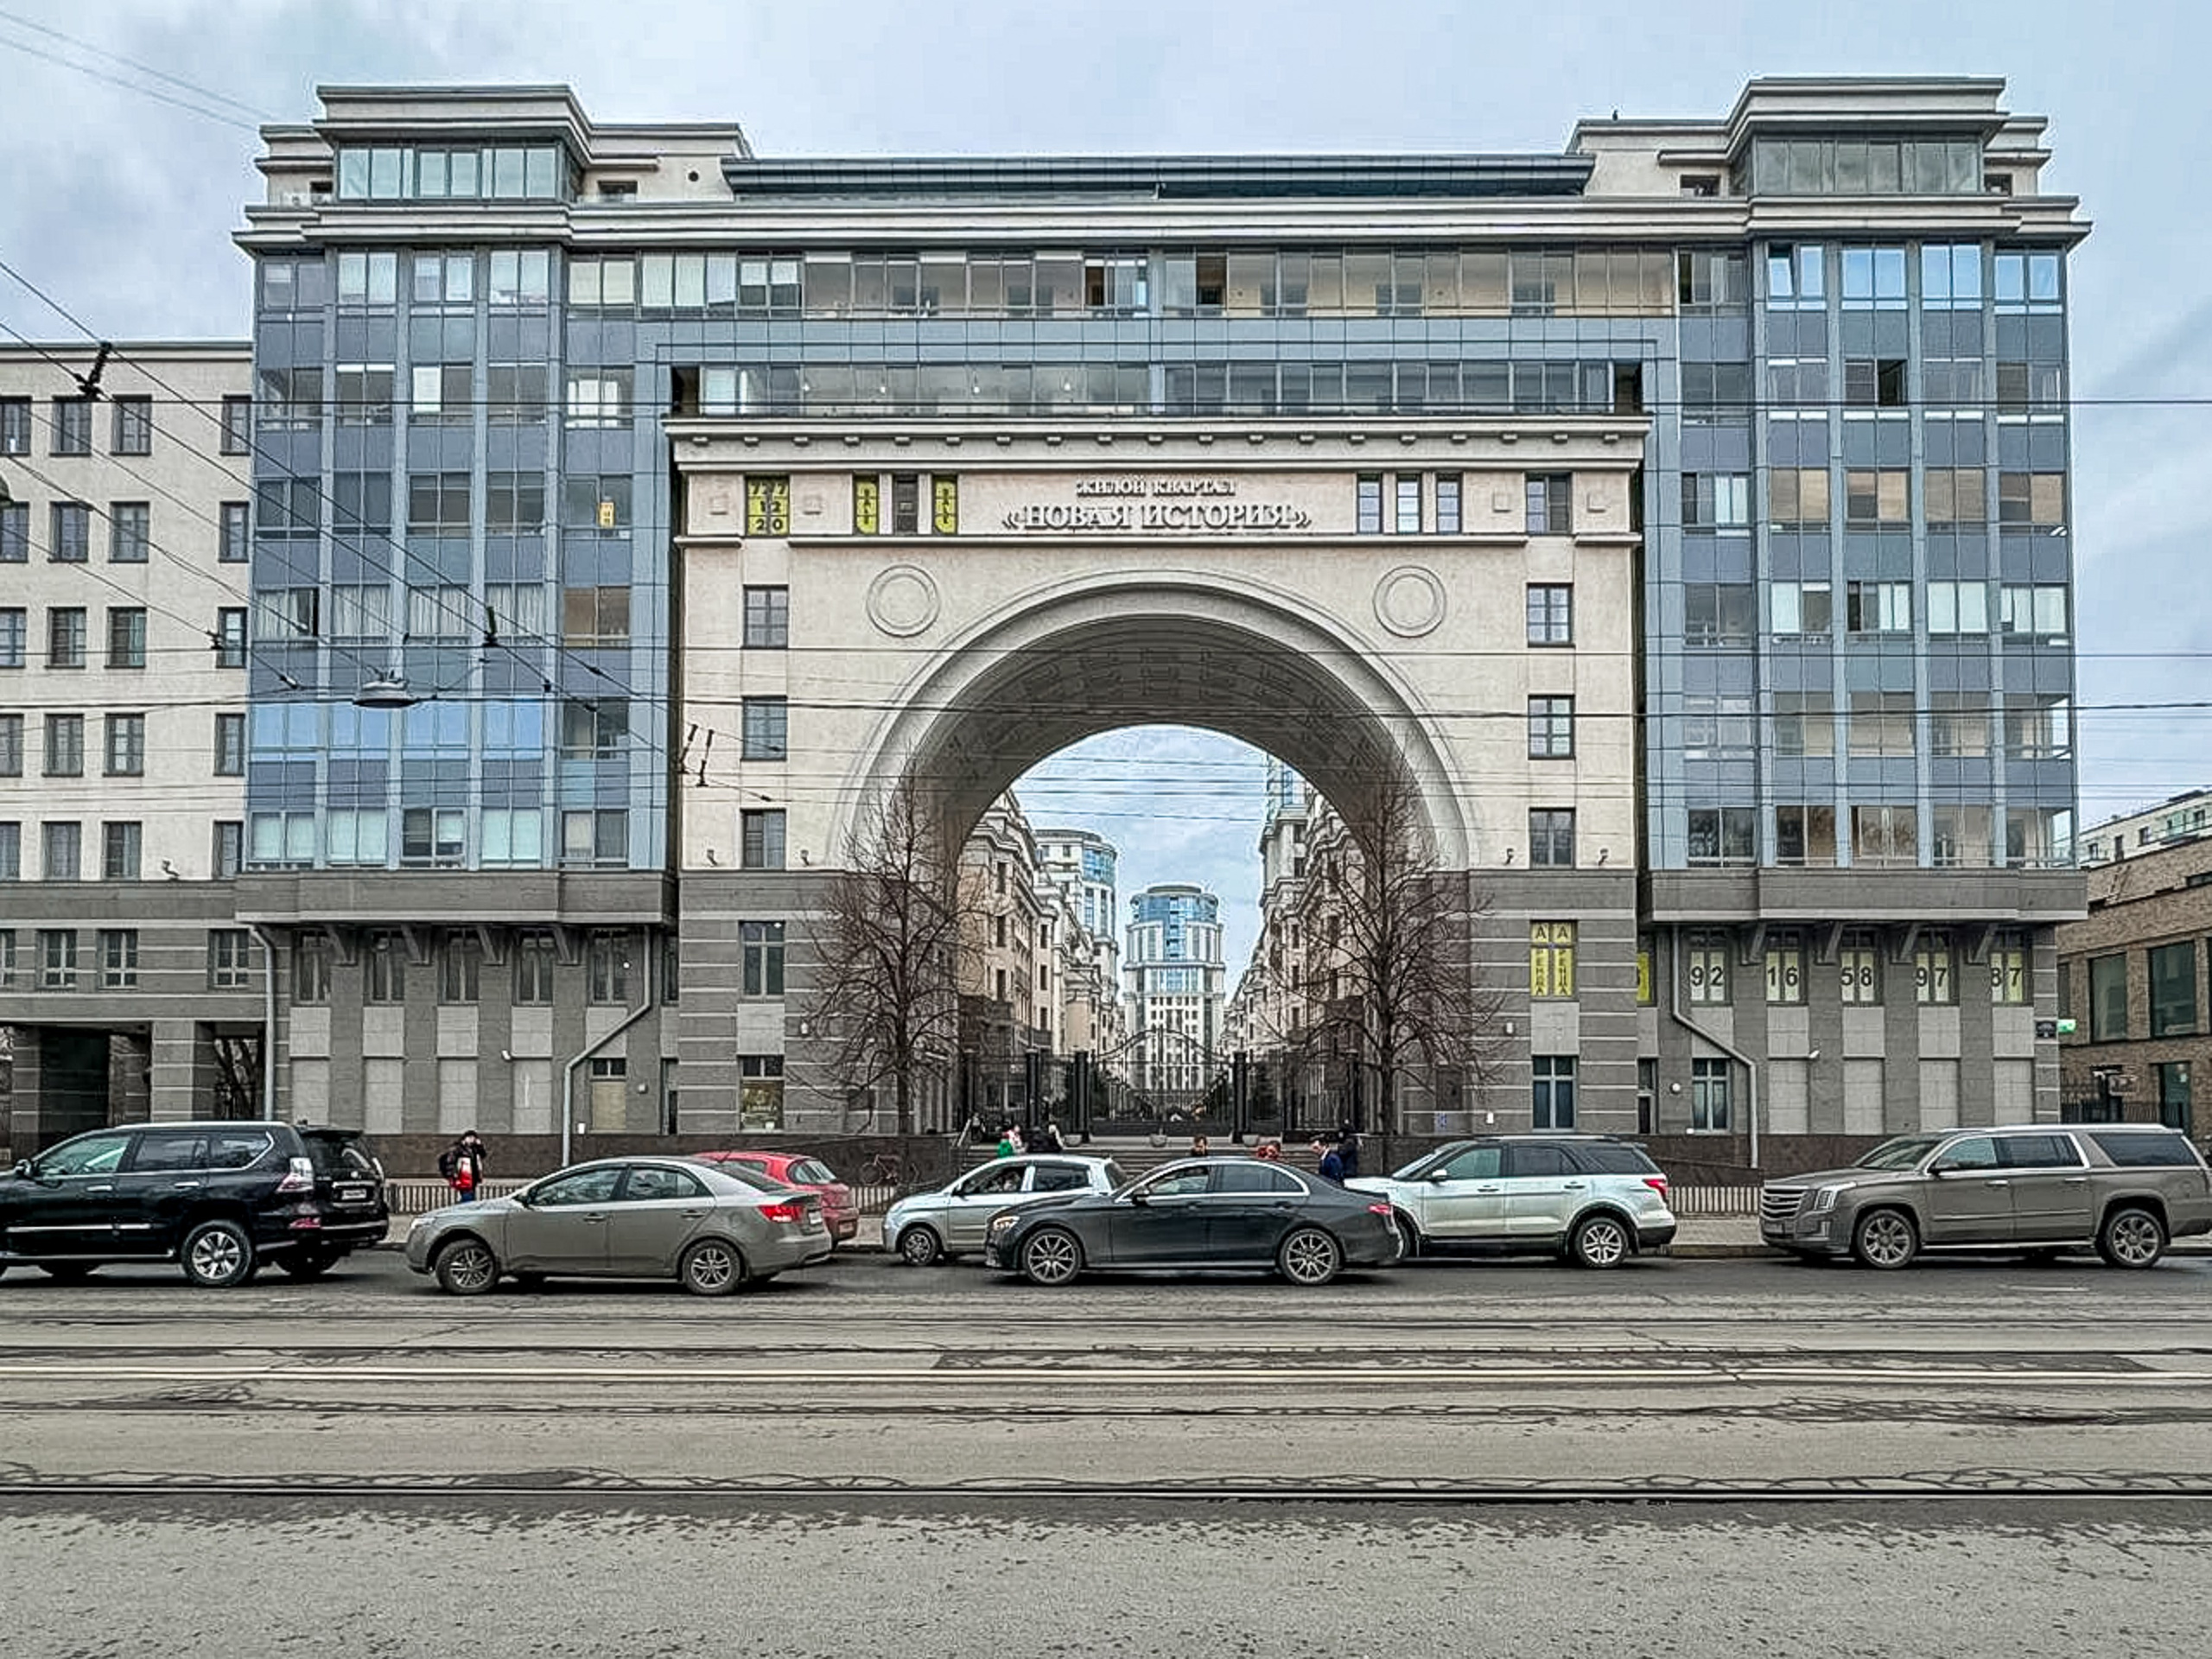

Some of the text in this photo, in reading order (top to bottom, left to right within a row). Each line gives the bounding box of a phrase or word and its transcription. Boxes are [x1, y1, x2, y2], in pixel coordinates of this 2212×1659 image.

[1076, 476, 1236, 496] ЖИЛОЙ КВАРТАЛ
[755, 518, 784, 531] 20
[1001, 504, 1313, 530] «НОВАЯ ИСТОРИЯ»
[1691, 966, 2022, 988] 92 16 58 97 87
